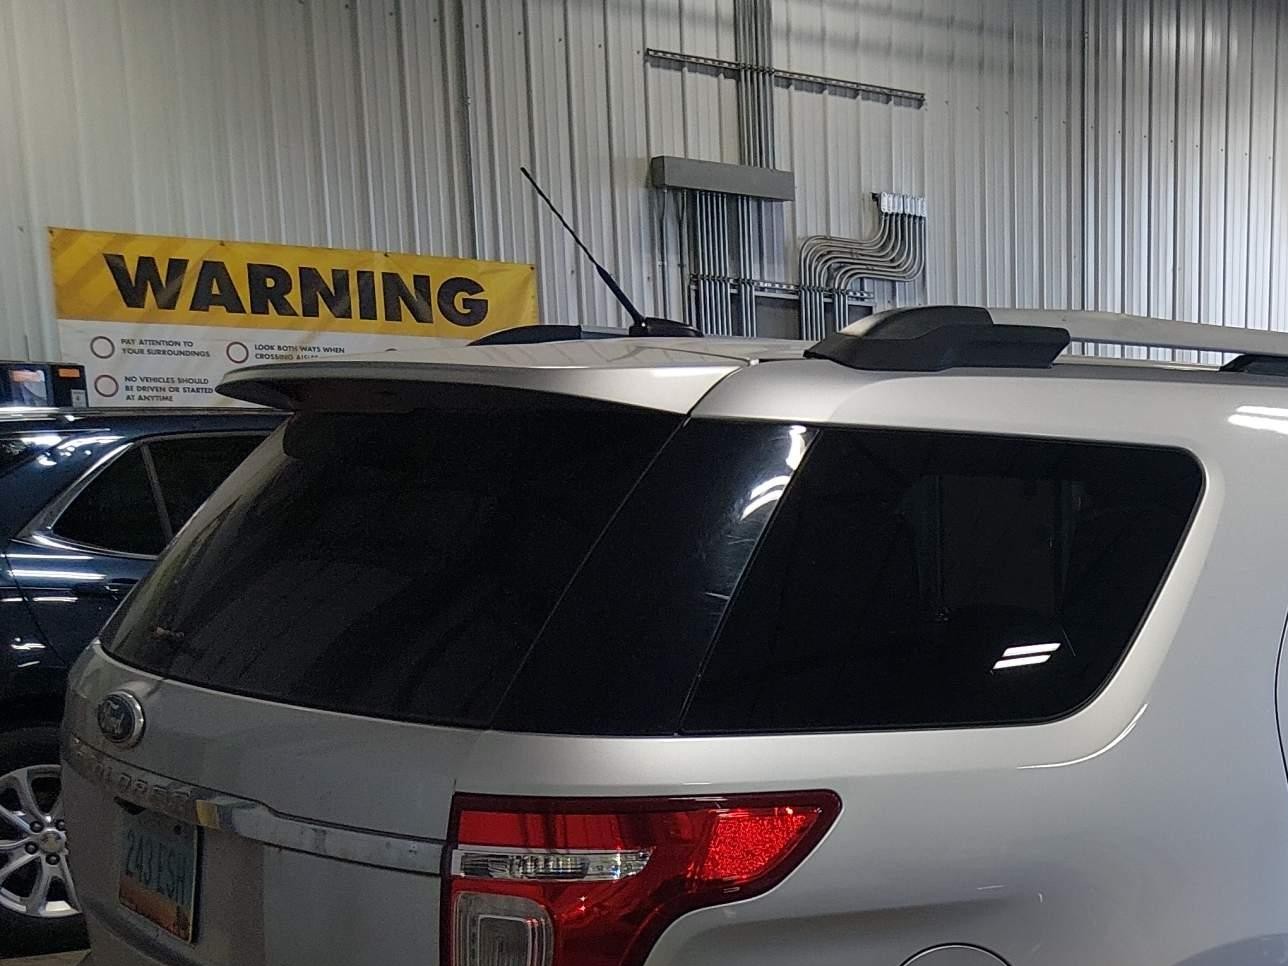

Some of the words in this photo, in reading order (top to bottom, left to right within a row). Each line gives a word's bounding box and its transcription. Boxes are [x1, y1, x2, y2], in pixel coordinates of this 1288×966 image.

[102, 252, 489, 327] WARNING
[120, 338, 136, 346] PAY
[139, 339, 181, 347] ATTENTION
[183, 340, 194, 348] TO
[121, 347, 145, 355] YOUR
[147, 348, 211, 358] SURROUNDINGS
[254, 343, 276, 351] LOOK
[277, 344, 298, 352] BOTH
[300, 345, 322, 353] WAYS
[322, 346, 345, 354] WHEN
[255, 353, 294, 361] CROSSING
[140, 376, 175, 384] VEHICLES
[177, 377, 209, 385] SHOULD
[136, 385, 167, 393] DRIVEN
[182, 386, 214, 394] STARTED
[126, 394, 136, 402] AT
